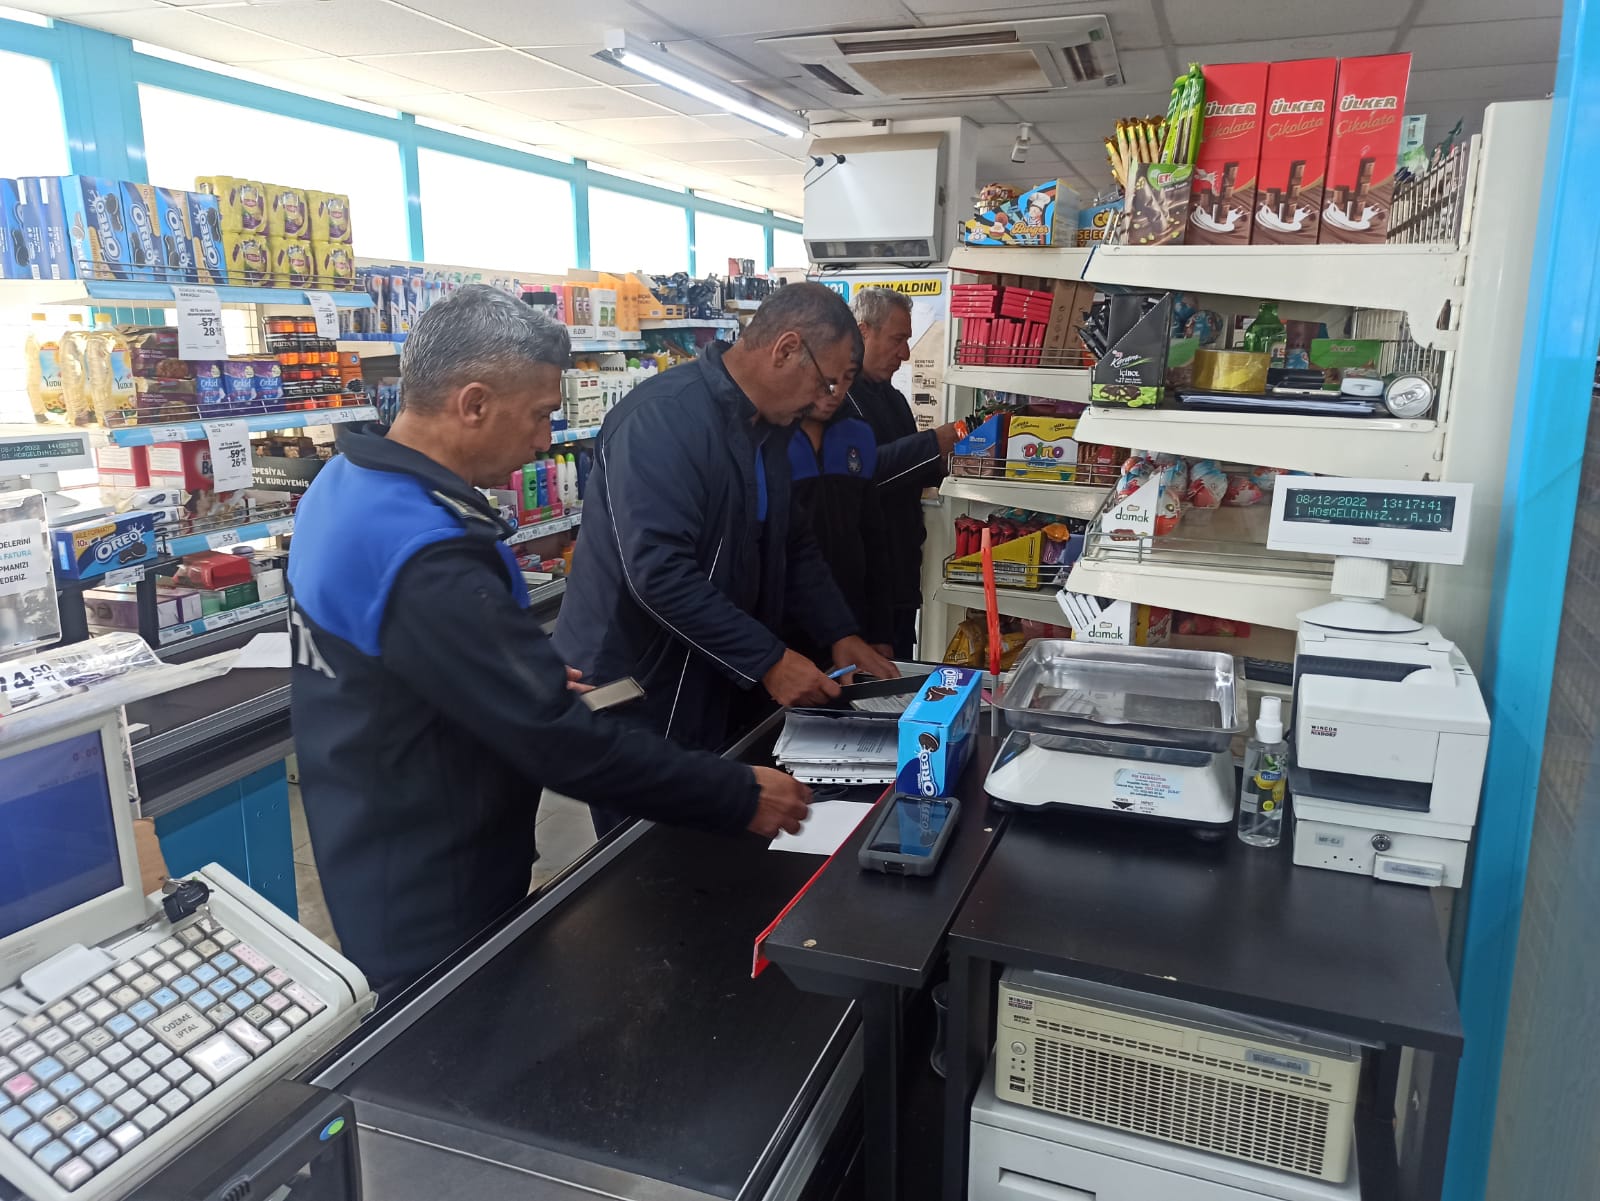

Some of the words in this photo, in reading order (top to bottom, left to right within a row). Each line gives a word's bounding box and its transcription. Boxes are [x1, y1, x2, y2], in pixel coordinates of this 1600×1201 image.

[1205, 101, 1255, 116] ÜLKER
[1271, 99, 1324, 114] ÜLKER
[1342, 96, 1397, 111] ÜLKER
[1266, 115, 1324, 141] Çikolata
[1336, 112, 1396, 137] Çikolata
[1011, 222, 1049, 237] Burger
[896, 282, 937, 293] ALDIN!
[203, 327, 216, 337] 28
[1023, 442, 1064, 459] Dino
[231, 459, 241, 468] 26
[1295, 494, 1368, 508] 08/12/2022
[1382, 497, 1442, 511] 13:17:41
[1115, 506, 1150, 523] damak
[96, 531, 139, 561] OREO
[3, 550, 32, 560] FATURA
[1088, 624, 1123, 640] damak
[942, 668, 958, 687] OREO
[920, 752, 935, 797] OREO
